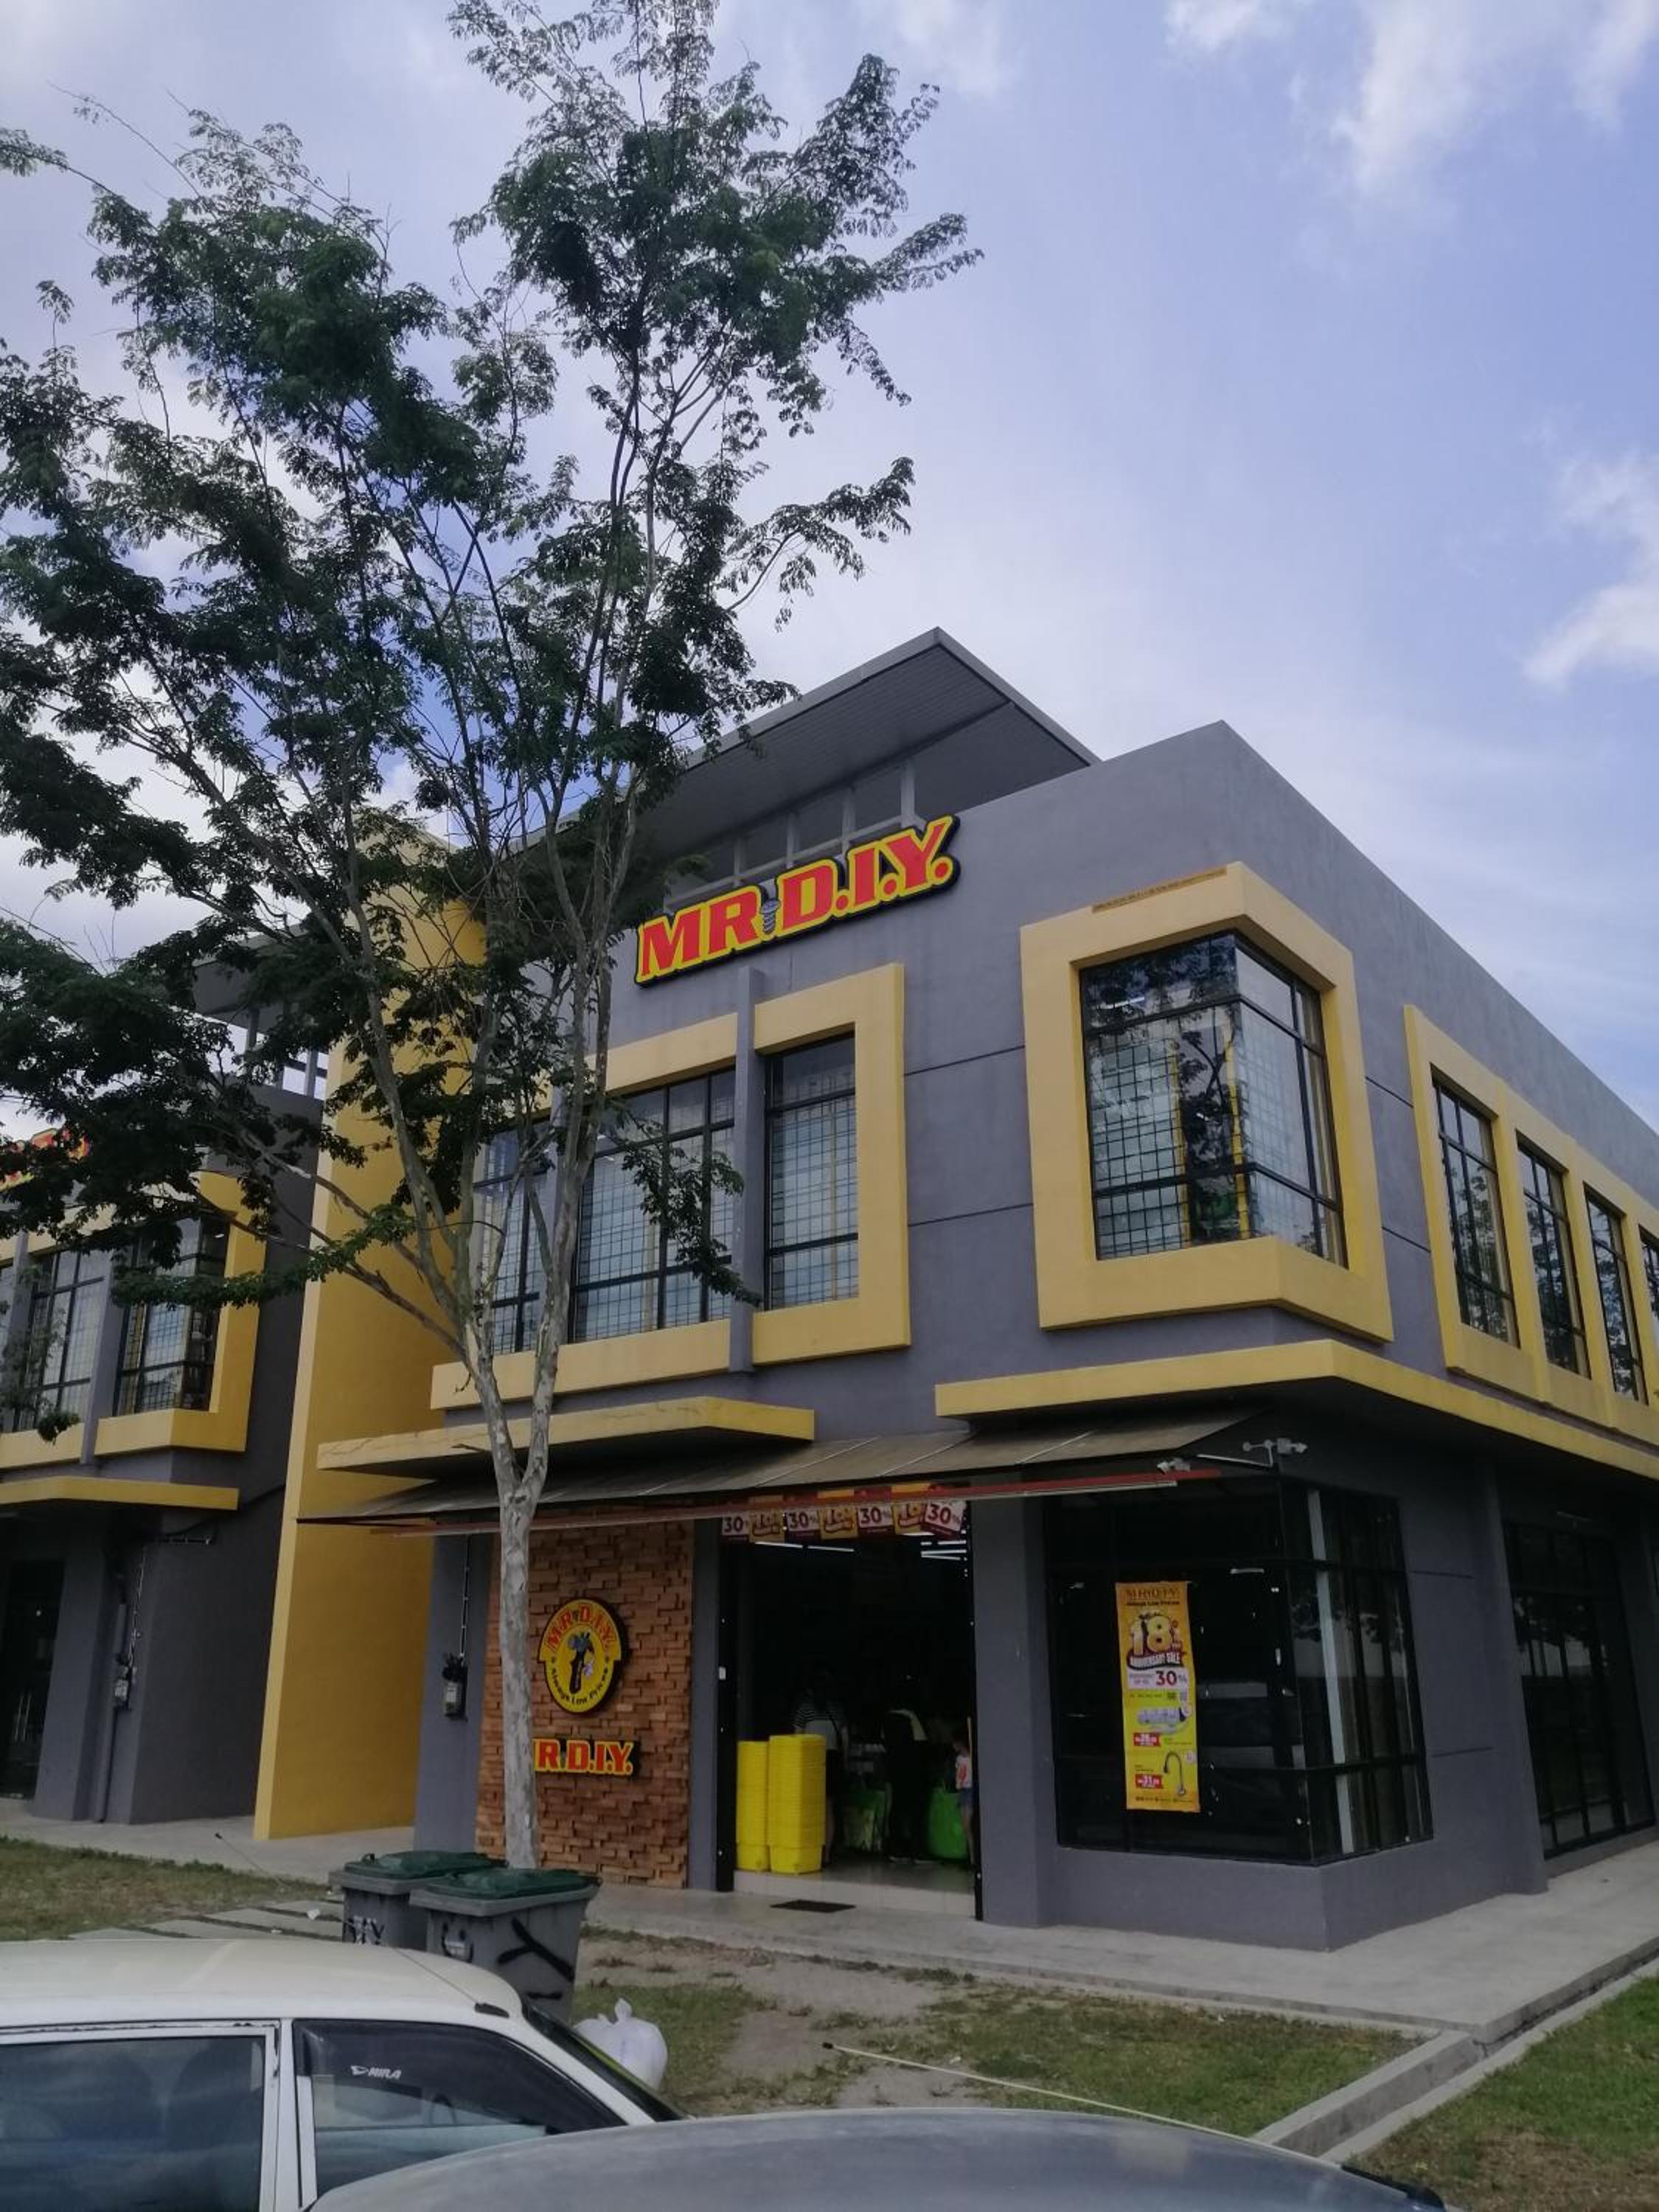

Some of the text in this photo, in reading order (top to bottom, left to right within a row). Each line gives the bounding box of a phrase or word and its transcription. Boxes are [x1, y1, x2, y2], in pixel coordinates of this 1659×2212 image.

[1131, 1615, 1172, 1657] 18
[566, 1741, 633, 1775] D.I.Y.
[367, 2067, 402, 2079] MIRA
